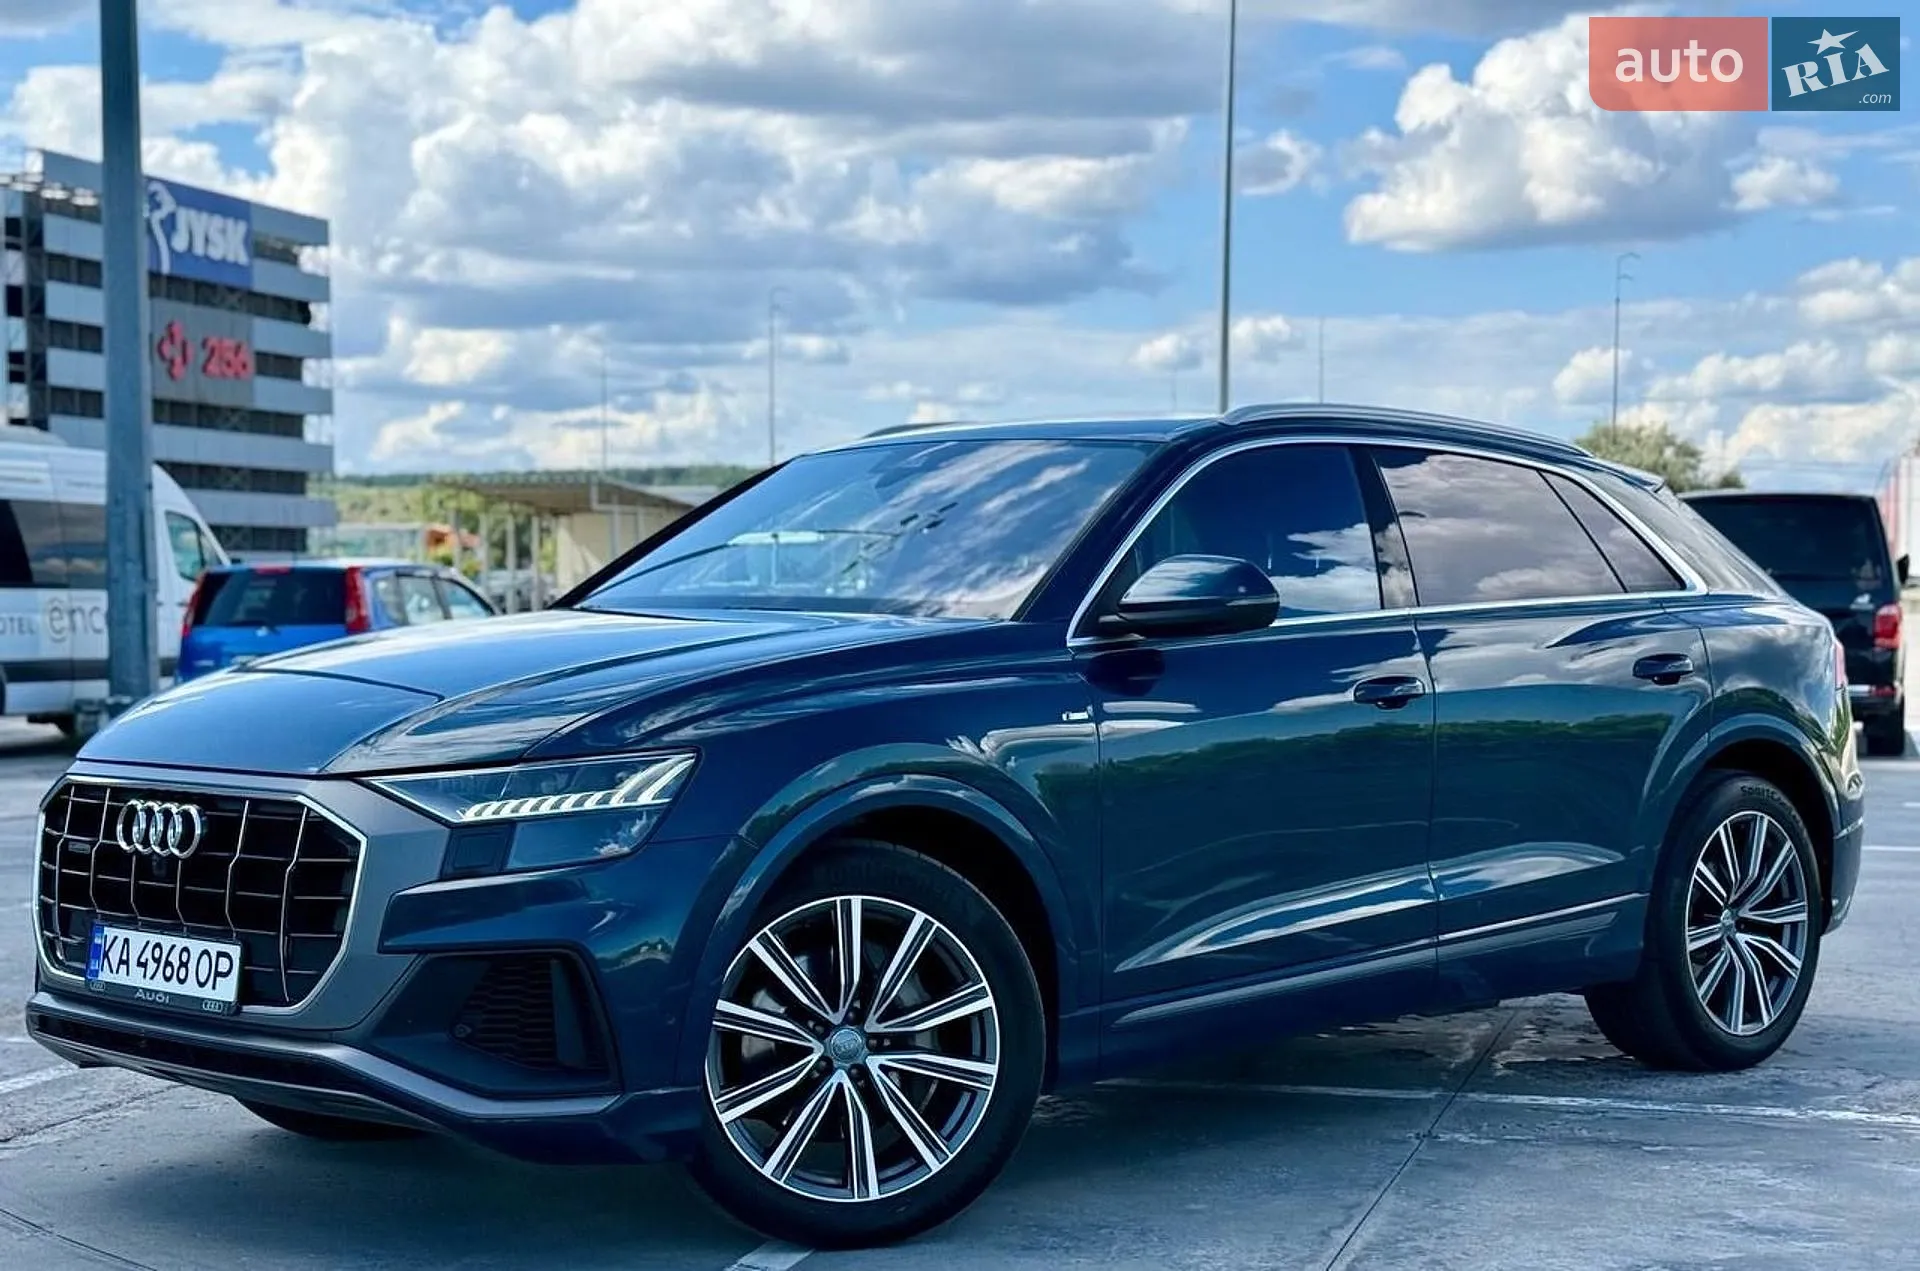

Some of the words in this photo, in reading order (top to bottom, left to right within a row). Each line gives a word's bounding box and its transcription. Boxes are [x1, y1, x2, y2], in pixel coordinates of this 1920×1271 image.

[171, 206, 249, 266] JYSK
[202, 336, 254, 378] 256
[100, 934, 130, 977] KA
[136, 940, 191, 985] 4968
[195, 948, 233, 990] OP
